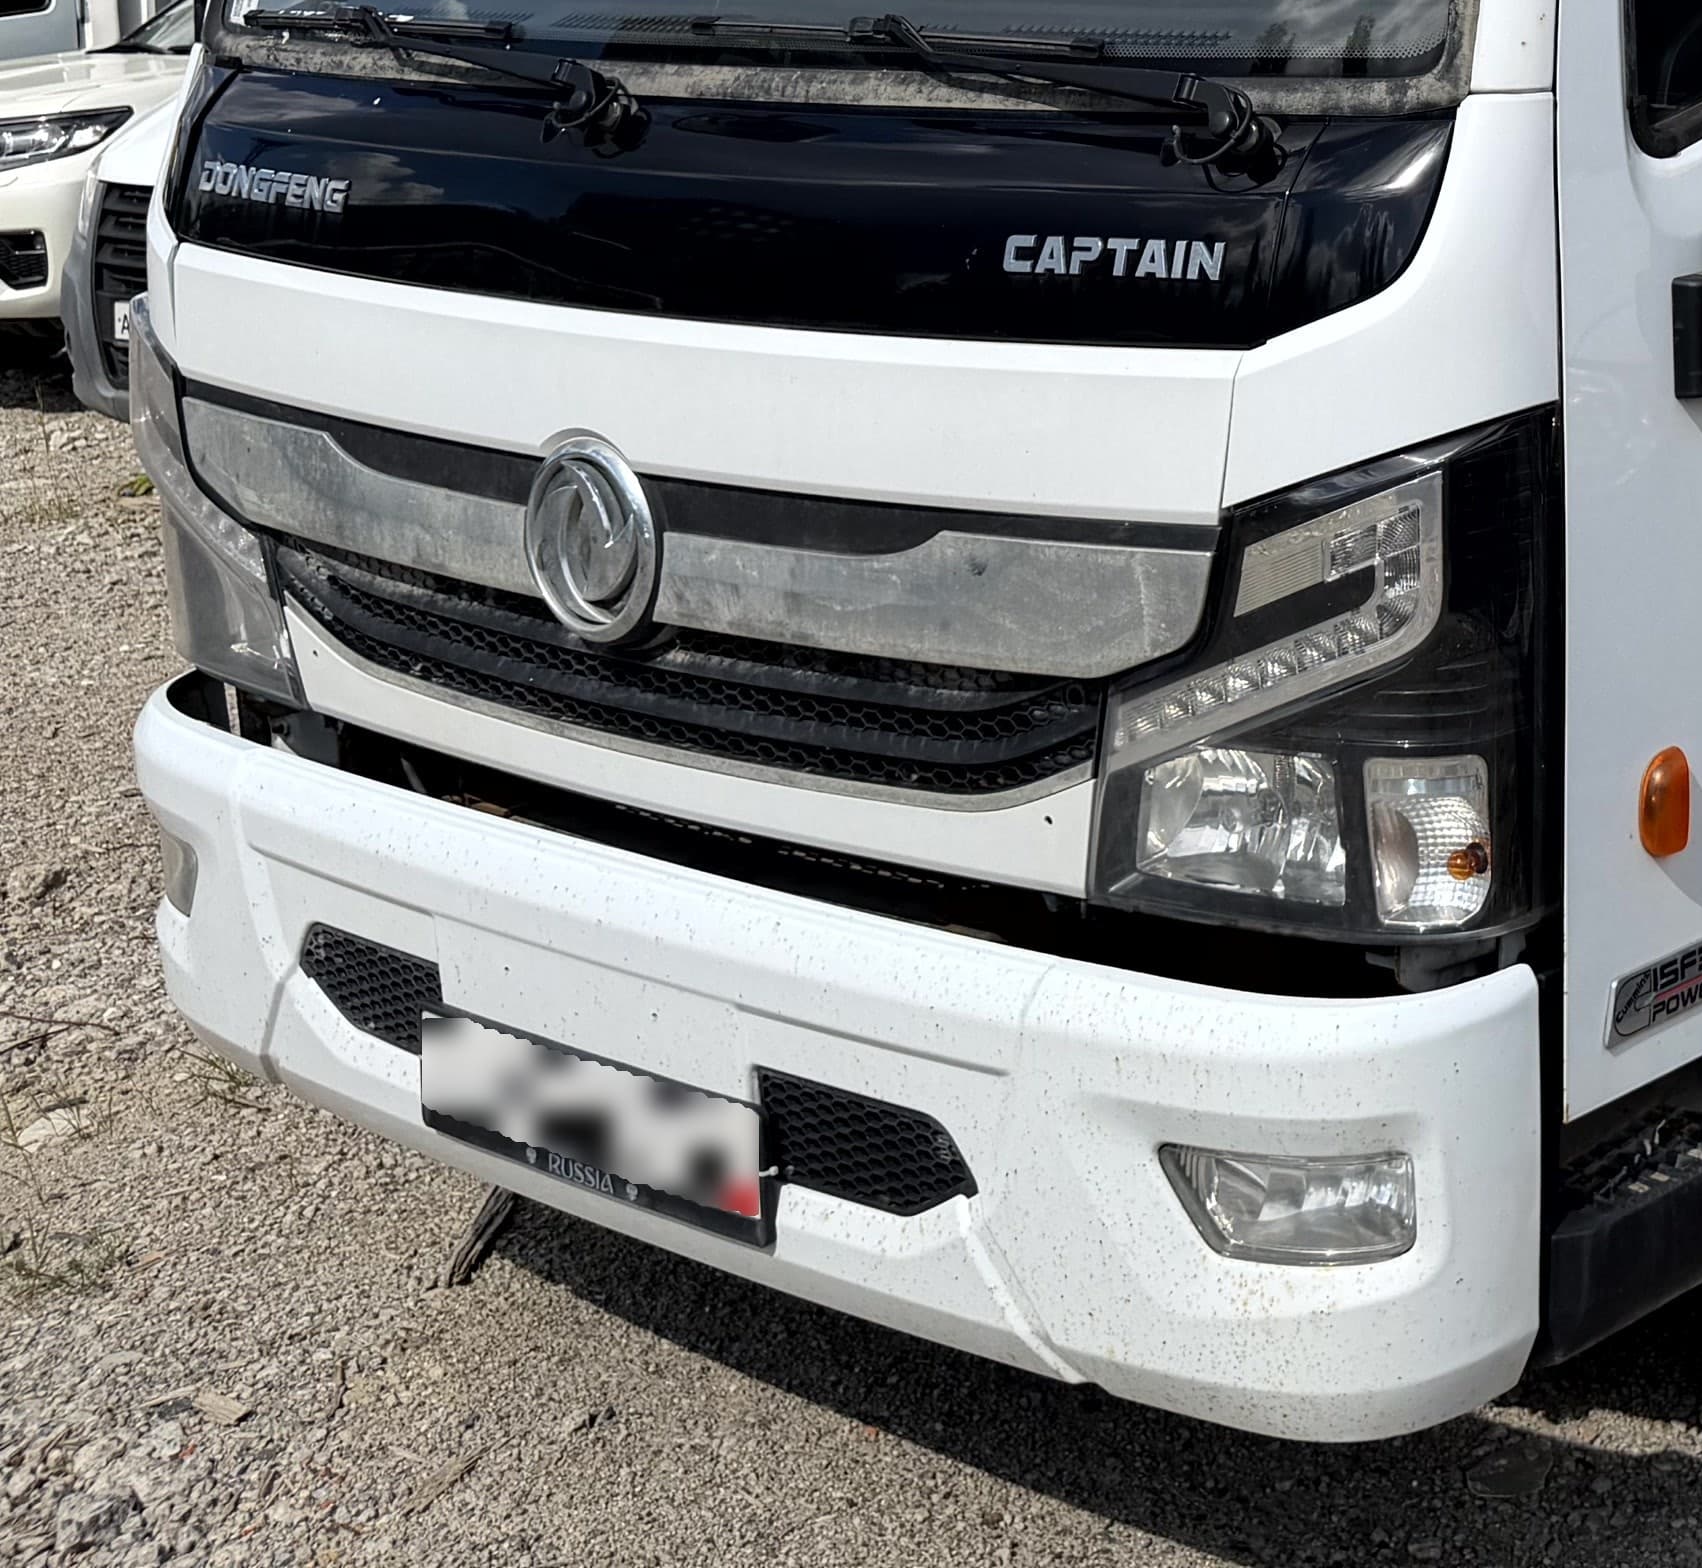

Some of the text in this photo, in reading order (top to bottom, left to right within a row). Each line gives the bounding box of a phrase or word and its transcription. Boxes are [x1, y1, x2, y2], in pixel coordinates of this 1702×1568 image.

[199, 160, 350, 213] DONGFENG
[1003, 234, 1226, 281] CAPTAIN
[549, 1152, 614, 1195] RUSSIA
